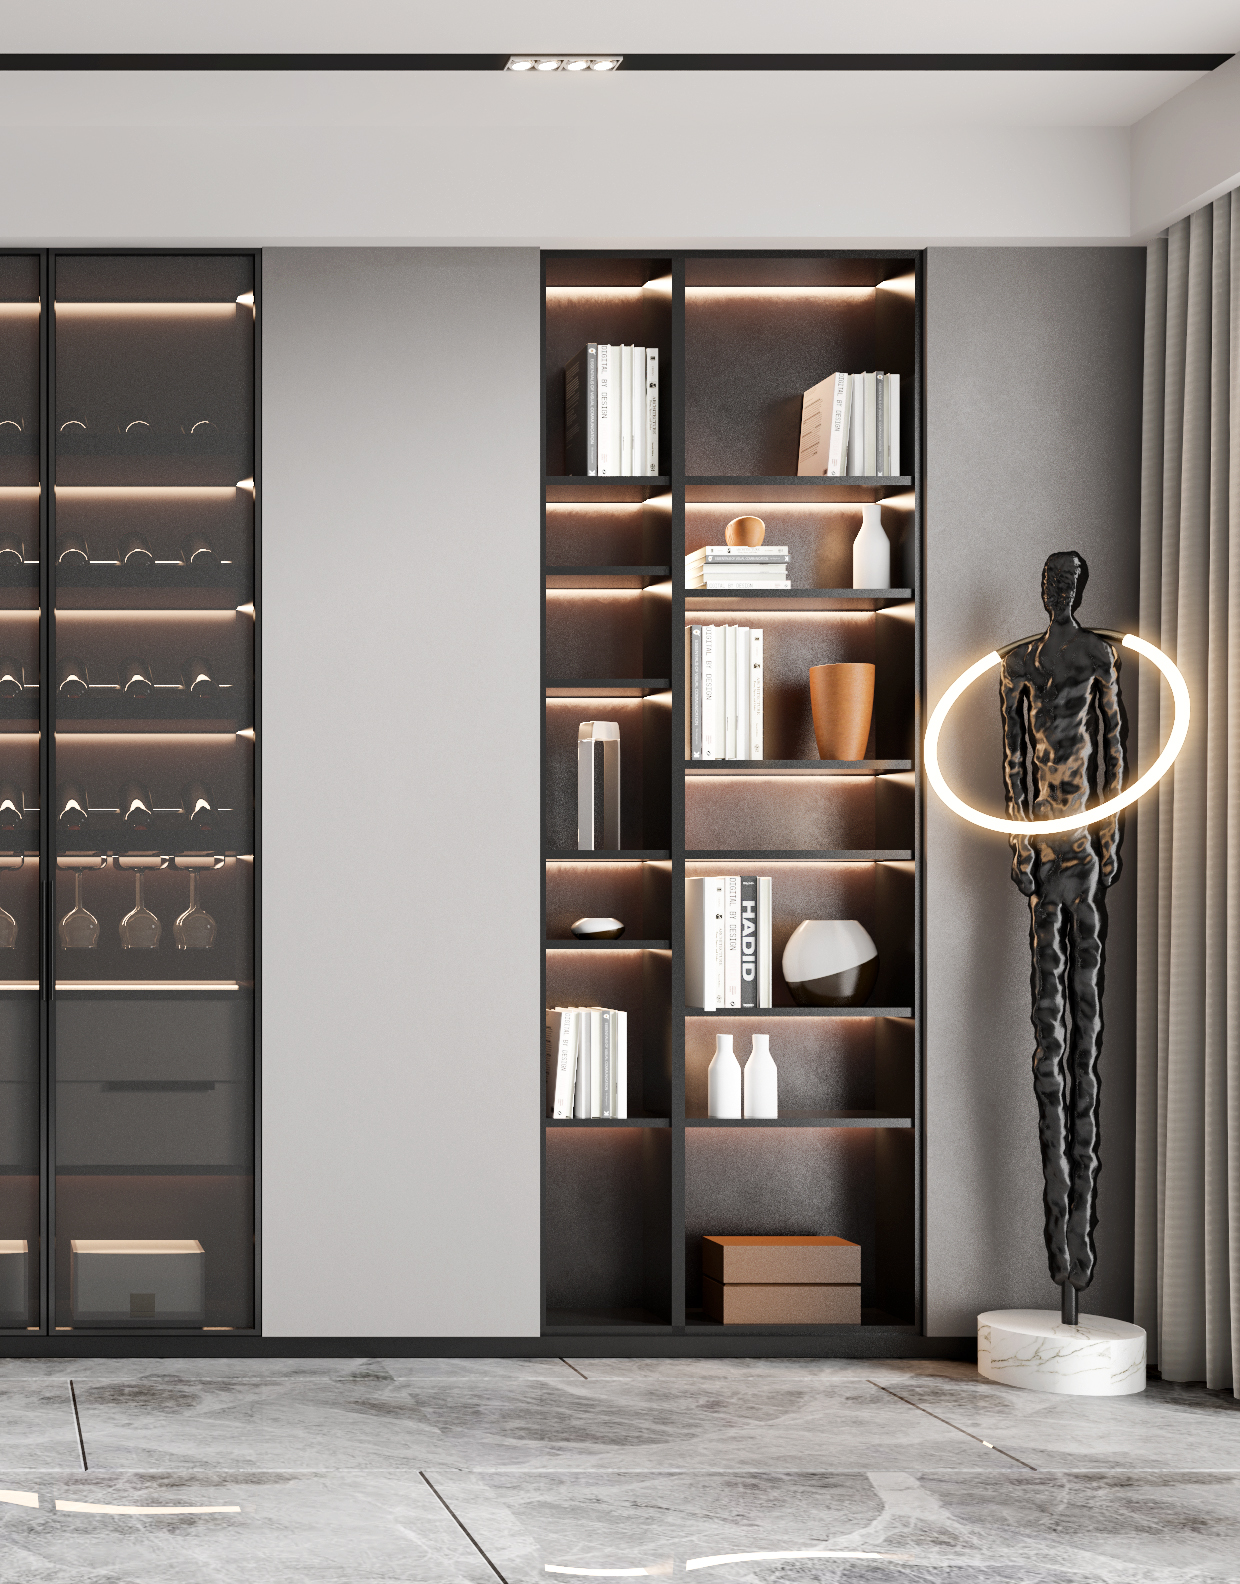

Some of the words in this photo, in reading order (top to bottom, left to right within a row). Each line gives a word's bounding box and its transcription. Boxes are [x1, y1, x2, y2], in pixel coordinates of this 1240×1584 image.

[601, 379, 608, 388] BY
[837, 373, 845, 396] DIGITAL
[836, 399, 843, 407] BY
[834, 410, 842, 432] DESIGN
[705, 627, 713, 656] DIGITAL
[705, 660, 713, 669] BY
[705, 673, 713, 700] DESIGN
[729, 911, 736, 919] BY
[742, 900, 756, 981] HADID
[563, 1013, 571, 1035] DIGITAL
[560, 1049, 568, 1072] DESIGN
